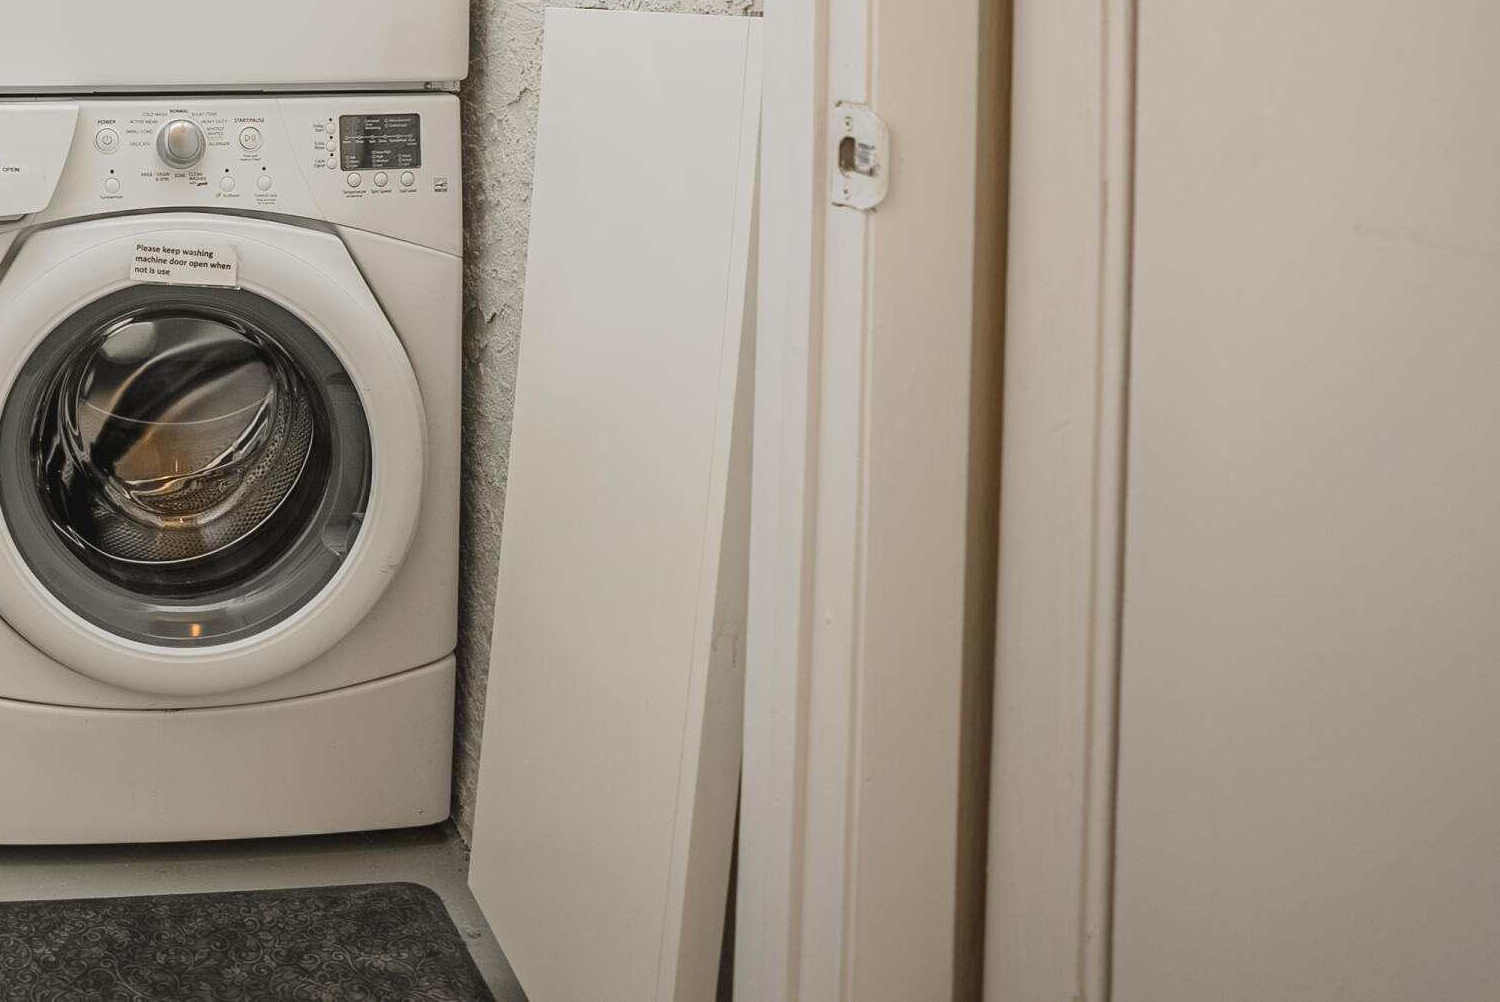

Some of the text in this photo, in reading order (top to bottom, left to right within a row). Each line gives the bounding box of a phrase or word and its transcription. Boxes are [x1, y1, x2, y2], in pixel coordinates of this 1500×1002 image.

[136, 244, 214, 259] Please keep washing
[135, 255, 232, 270] machine door open when
